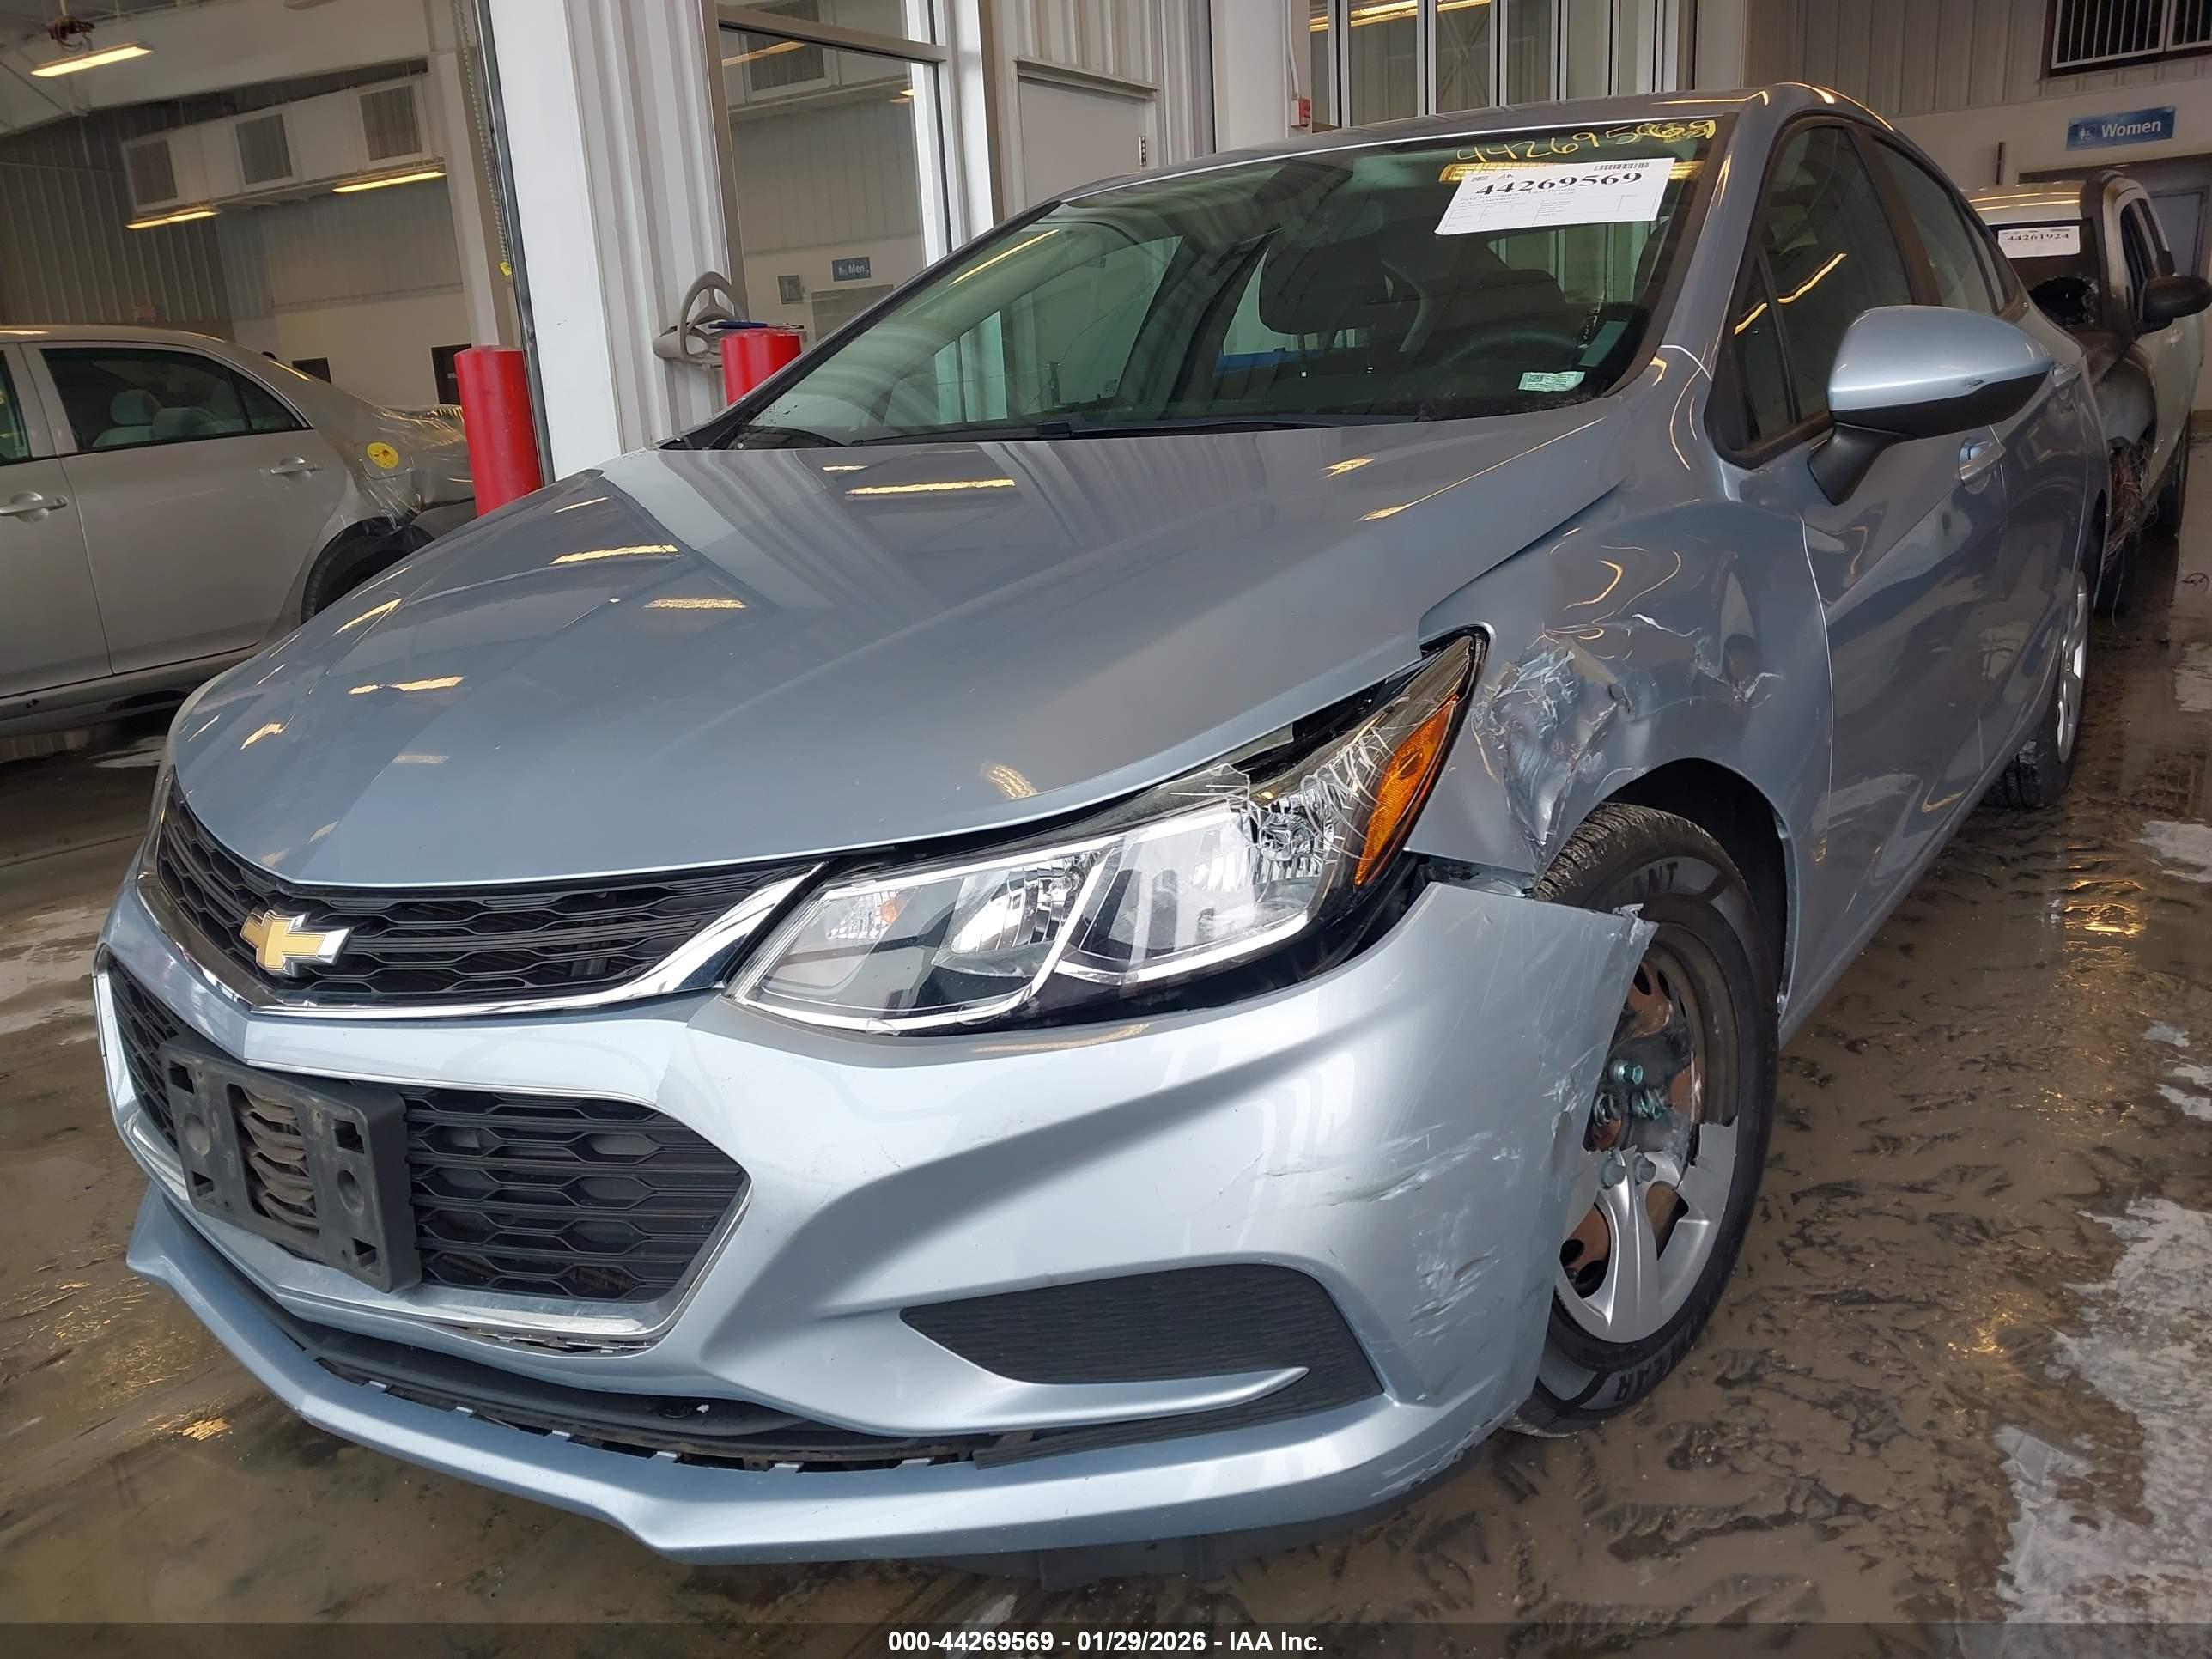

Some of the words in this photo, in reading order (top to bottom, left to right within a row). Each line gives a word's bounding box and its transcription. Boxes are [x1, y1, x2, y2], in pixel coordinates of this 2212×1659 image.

[2101, 118, 2162, 138] Women
[1474, 172, 1643, 196] 44269569
[2007, 233, 2069, 241] 44261924
[848, 264, 865, 274] Men
